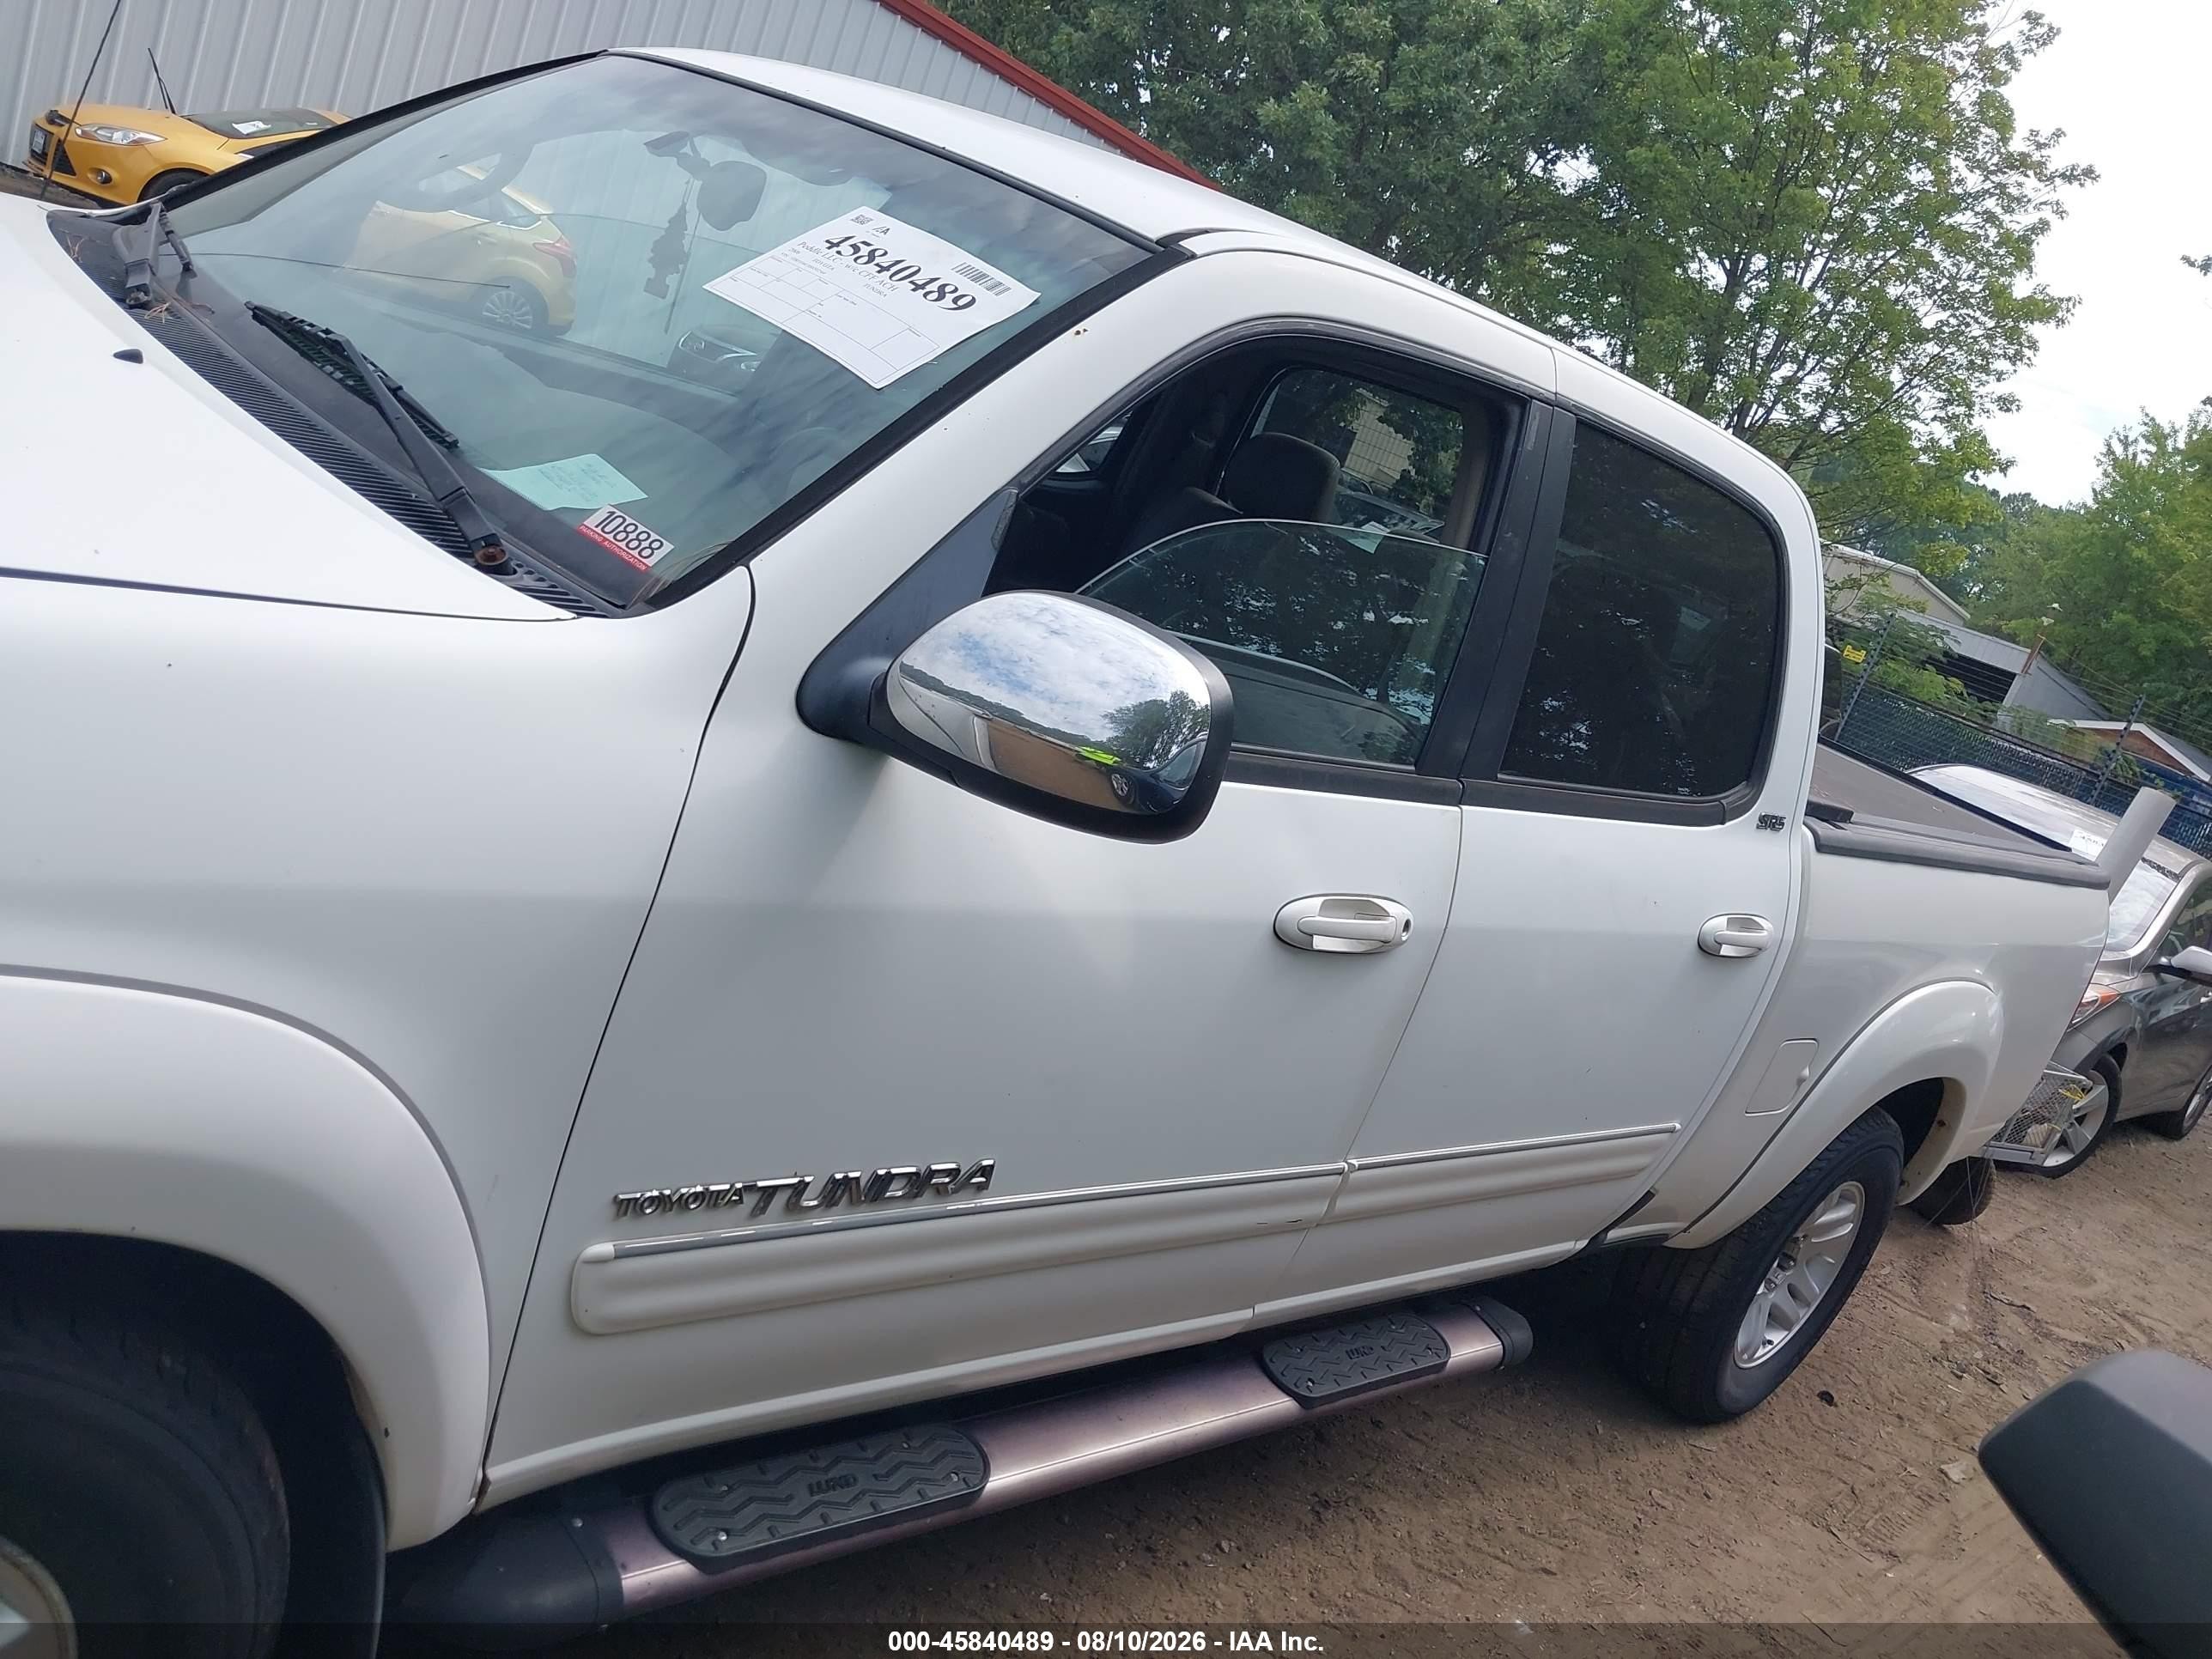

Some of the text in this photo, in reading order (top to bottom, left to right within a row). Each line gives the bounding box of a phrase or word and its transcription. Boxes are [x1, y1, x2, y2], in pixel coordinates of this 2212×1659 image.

[824, 235, 976, 311] 45840489
[578, 525, 648, 571] PARKING AUTHORIZATION
[594, 510, 665, 560] 10888
[612, 1158, 996, 1219] TOYOTA TUNDRA
